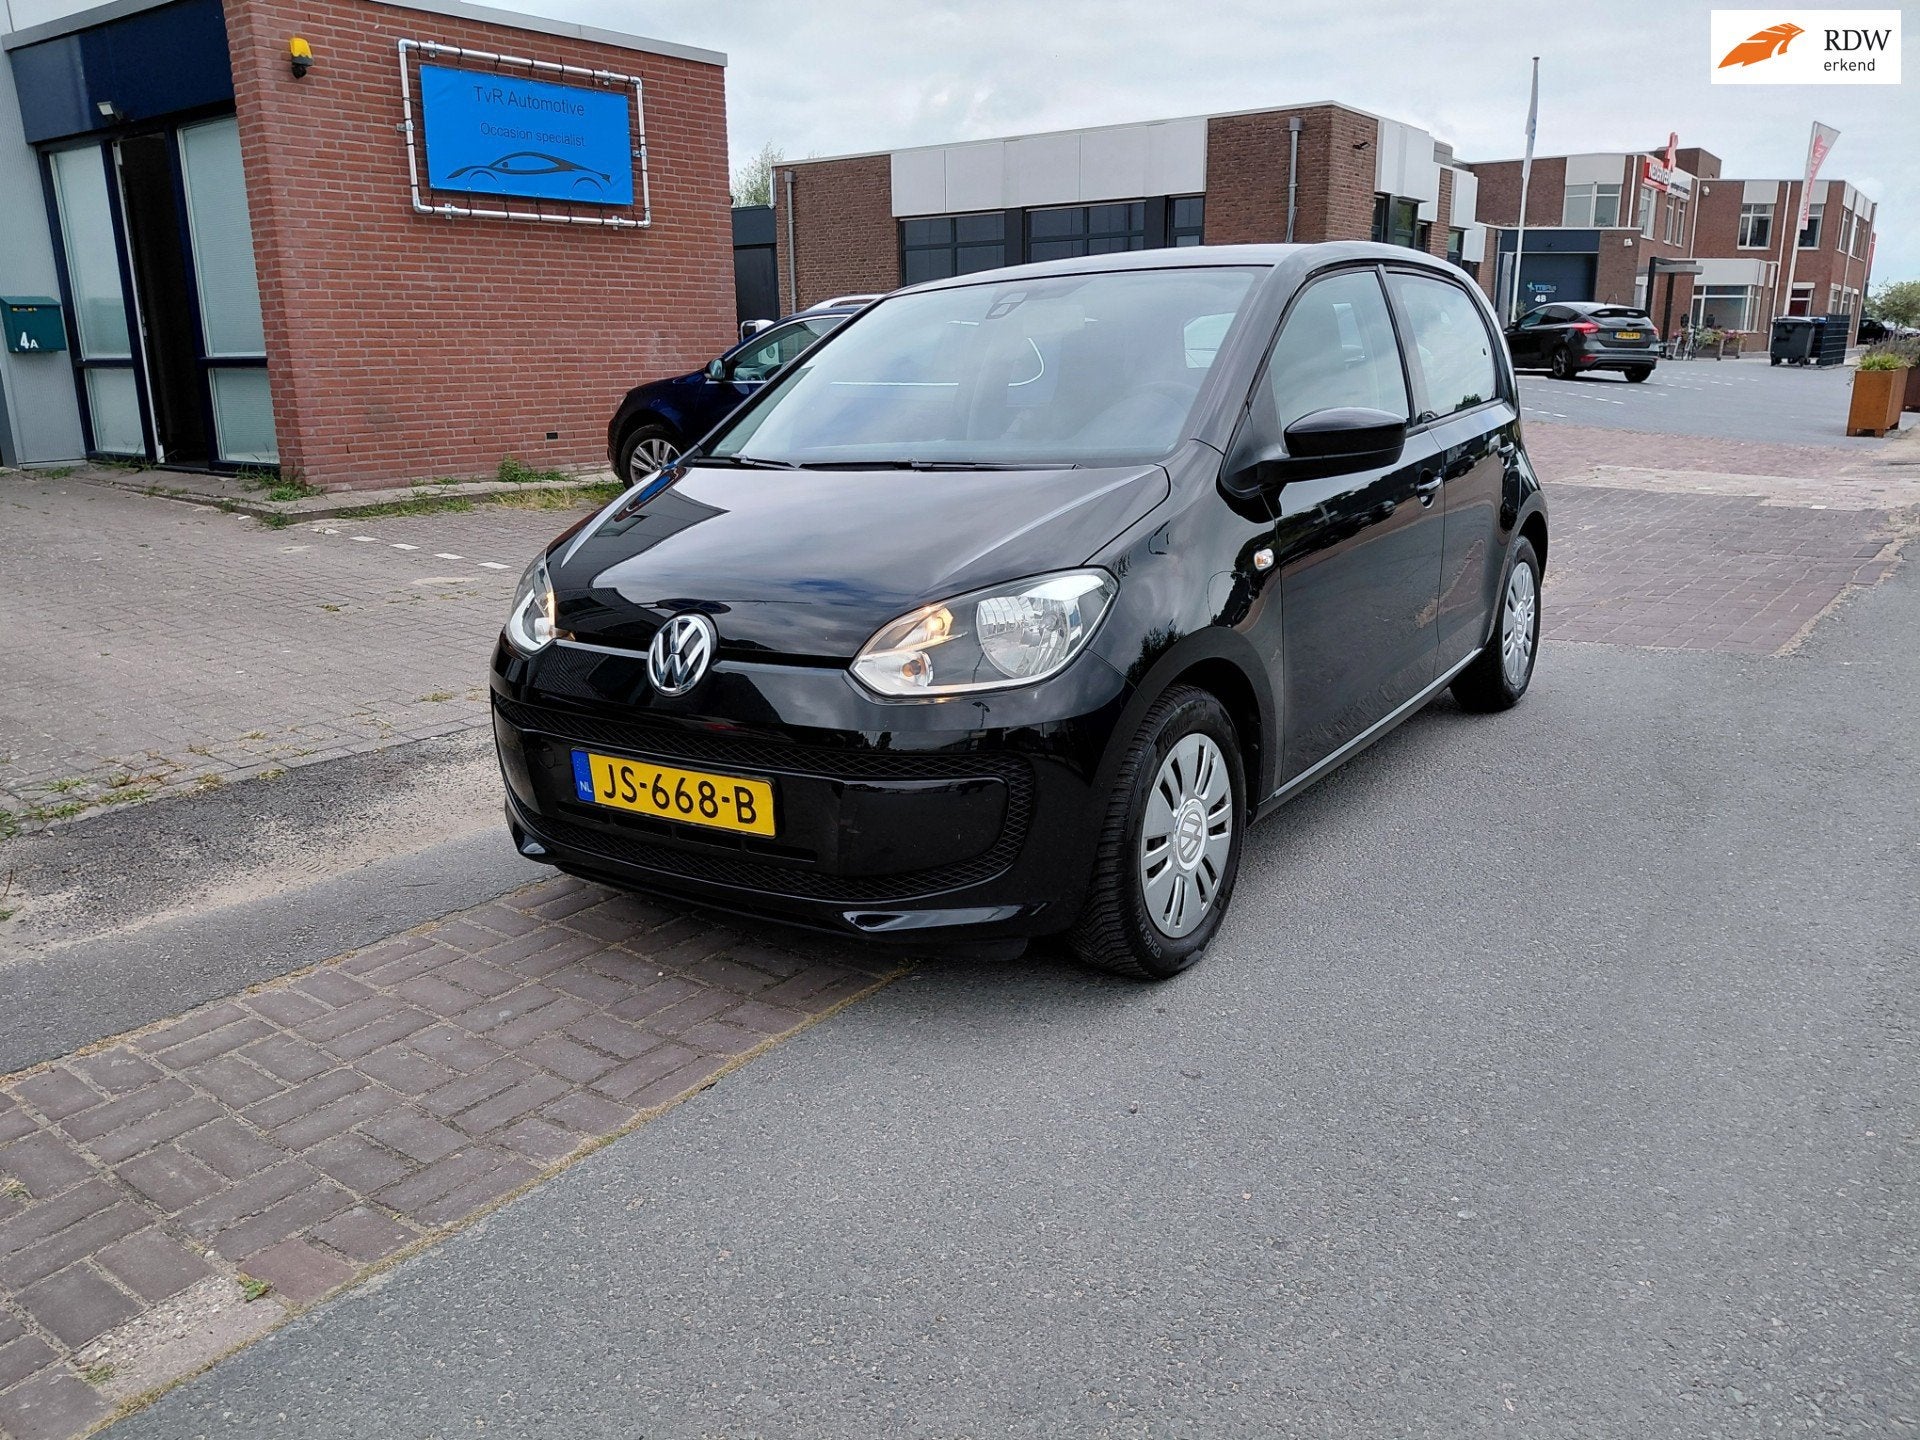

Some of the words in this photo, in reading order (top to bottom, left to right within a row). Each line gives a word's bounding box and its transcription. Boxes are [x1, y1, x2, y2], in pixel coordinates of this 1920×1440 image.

[474, 86, 504, 105] TvR
[507, 91, 585, 116] Automotive
[480, 122, 533, 141] Occasion
[535, 129, 586, 147] specialist
[20, 331, 39, 350] 4A
[579, 780, 593, 793] NL
[603, 763, 757, 825] JS-668-B
